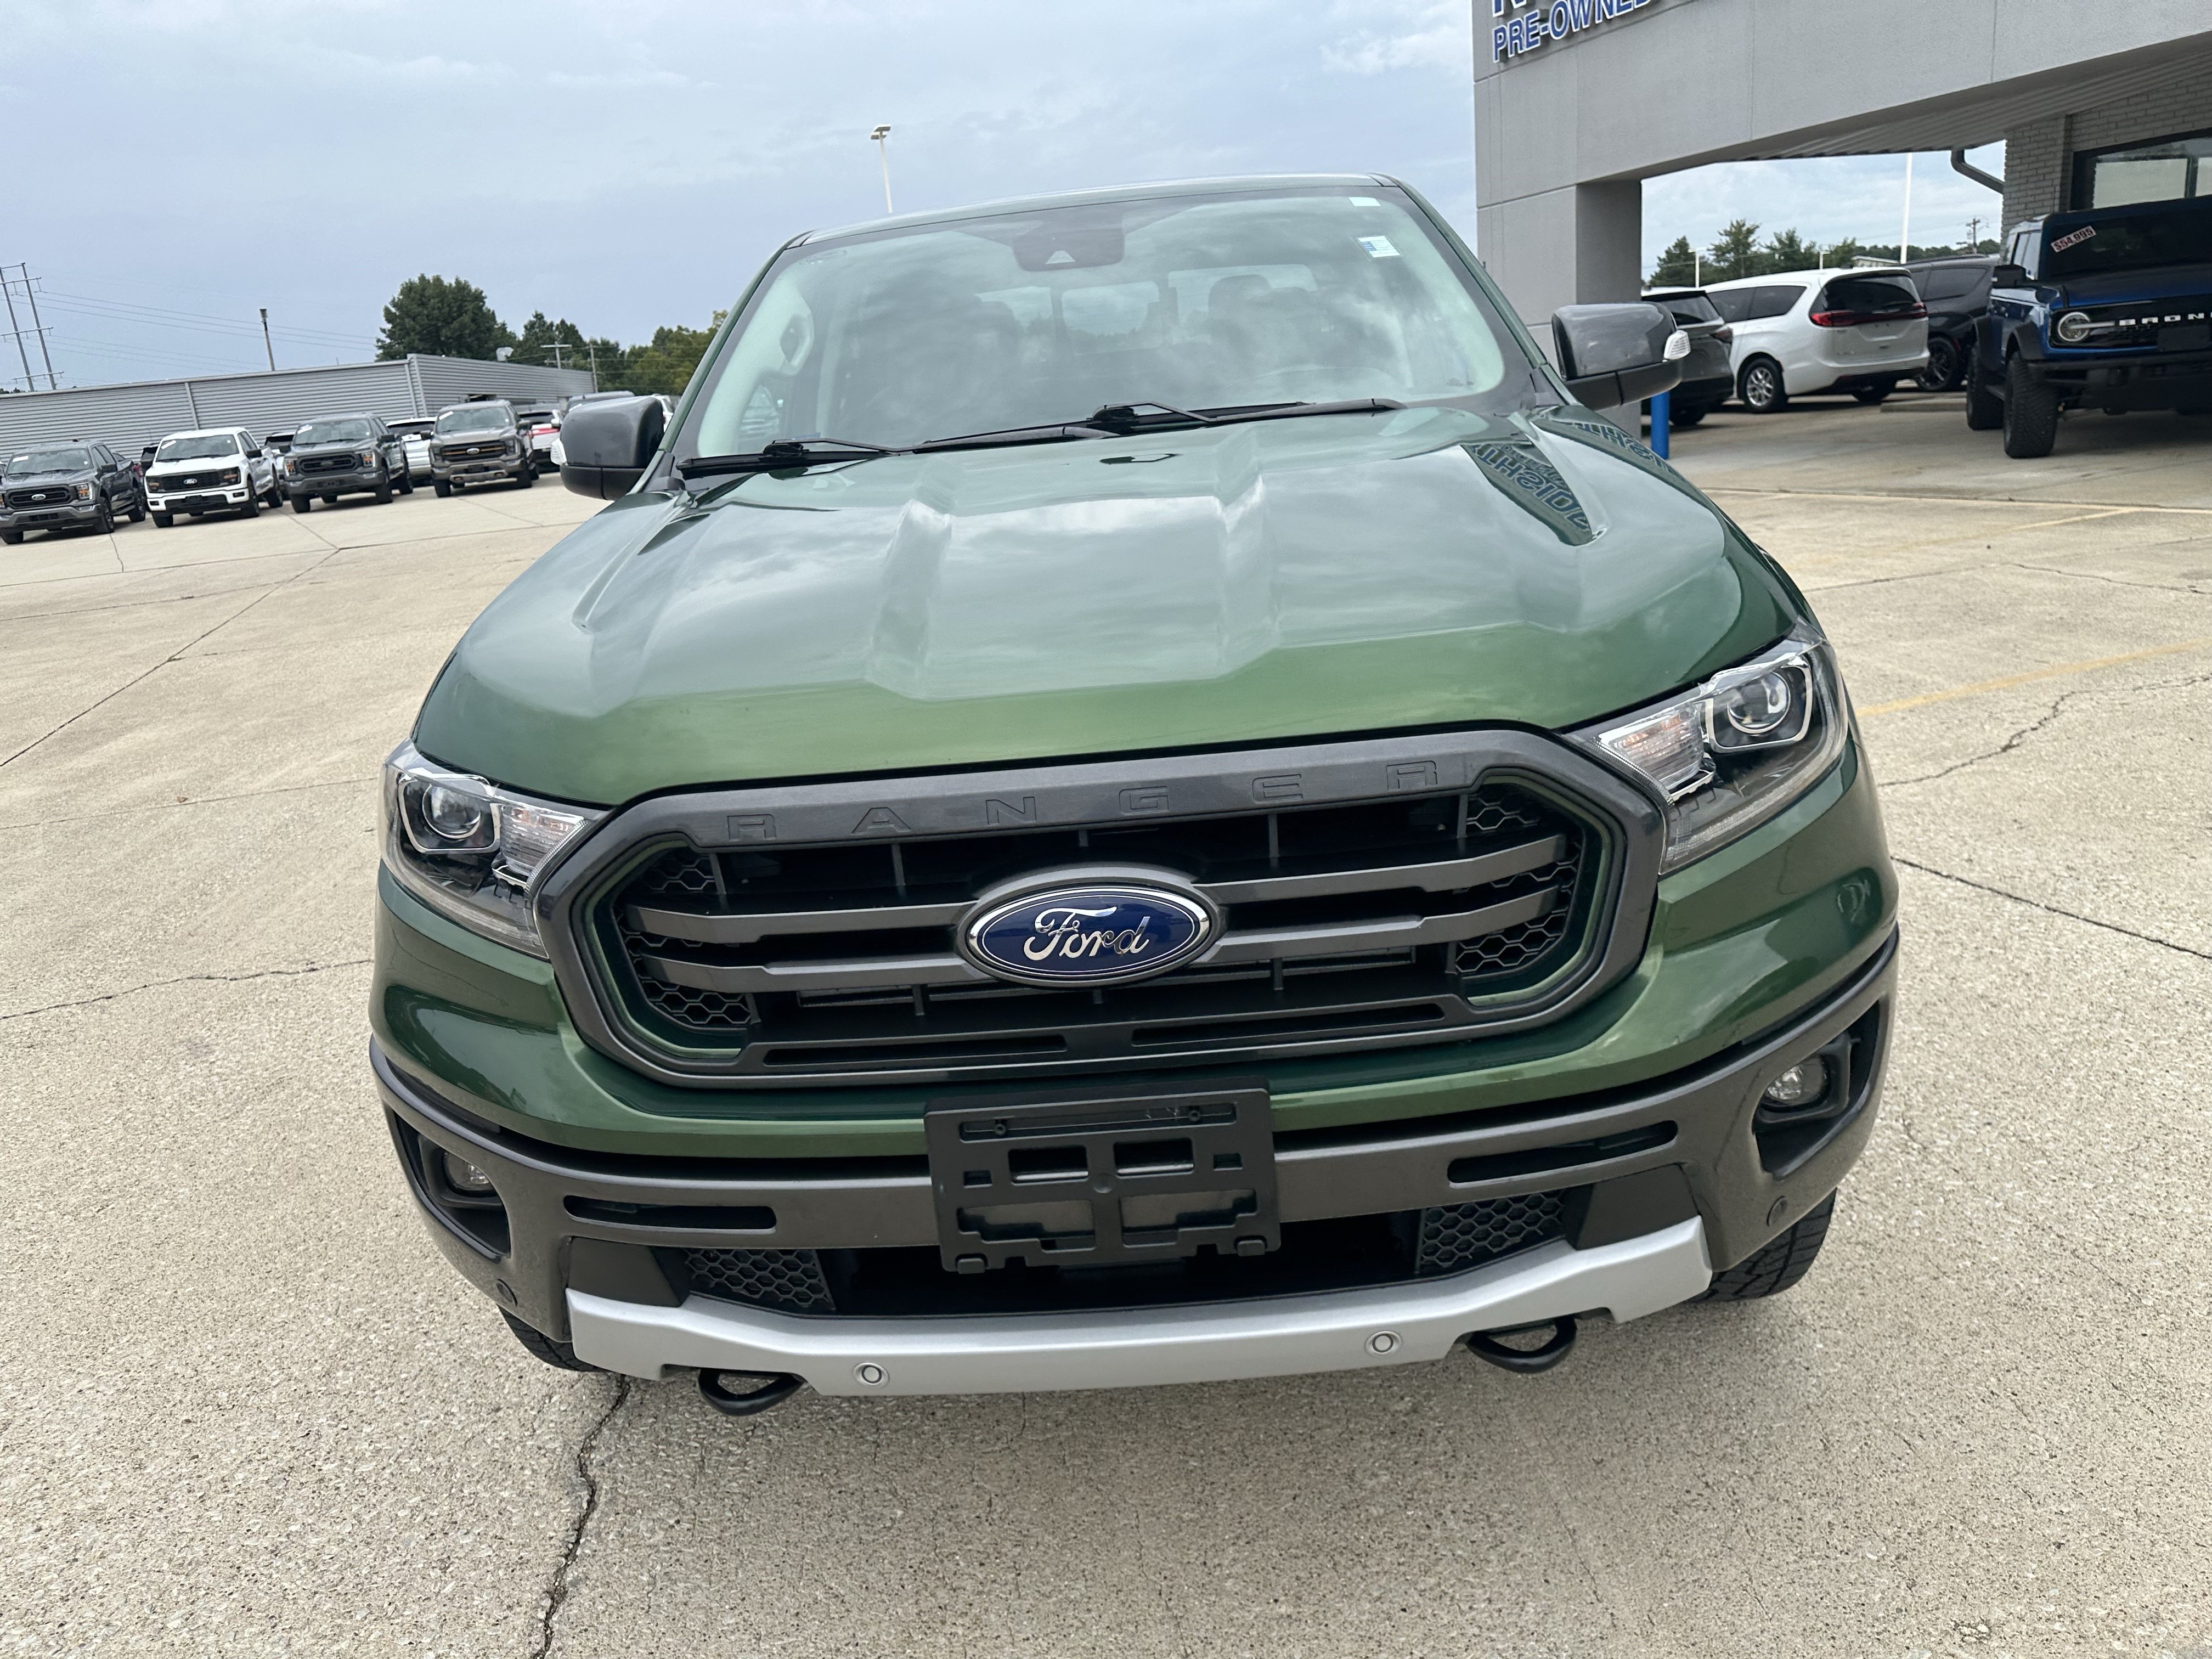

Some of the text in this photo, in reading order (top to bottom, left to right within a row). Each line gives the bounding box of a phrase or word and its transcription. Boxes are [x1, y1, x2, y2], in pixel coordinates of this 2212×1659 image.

[1492, 0, 1650, 63] PRE-OWN
[2119, 312, 2212, 326] BRON
[727, 760, 1438, 842] RANGER
[1024, 906, 1150, 961] Ford
